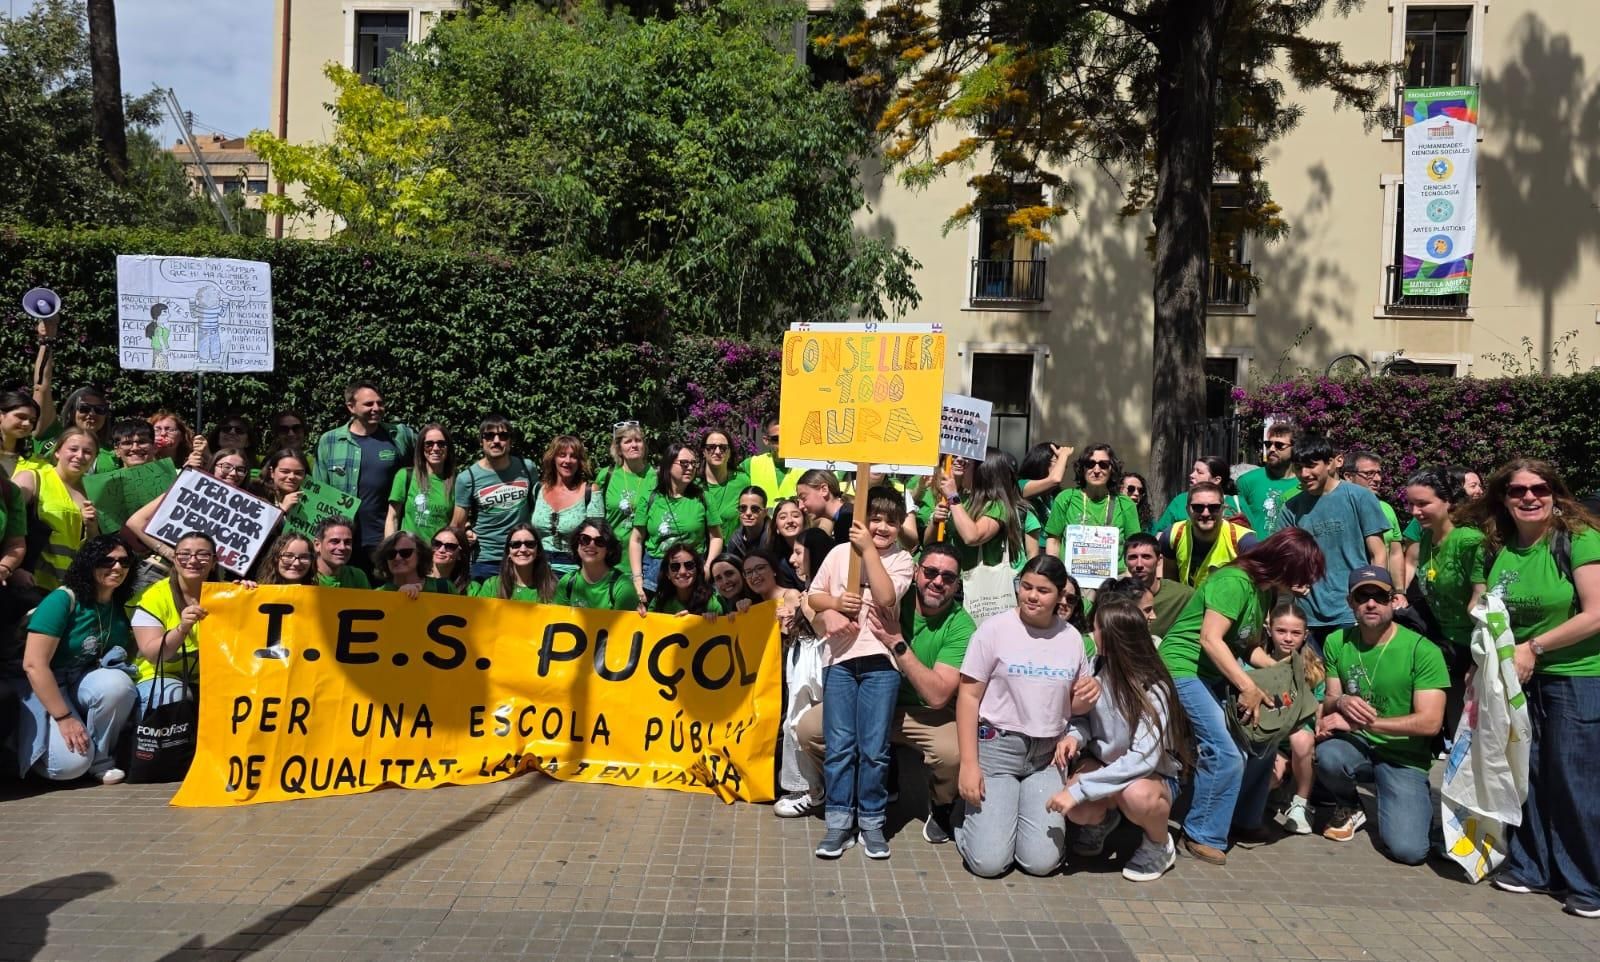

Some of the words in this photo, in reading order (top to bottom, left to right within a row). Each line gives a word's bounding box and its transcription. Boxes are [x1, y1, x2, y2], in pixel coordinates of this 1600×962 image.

[1418, 142, 1463, 150] HUMANIDADES
[124, 350, 150, 363] PAT
[229, 357, 268, 366] INFORMES
[785, 335, 945, 377] CONSELLERA
[800, 407, 924, 446] AURA
[940, 414, 975, 427] OCACIÓ,
[950, 407, 981, 419] SOBRA
[176, 487, 232, 525] TANTA
[228, 512, 263, 541] POR
[194, 476, 231, 505] PER
[228, 493, 266, 520] QUÈ
[336, 493, 355, 510] 30
[484, 489, 526, 507] SUPER
[169, 505, 251, 554] D'EDUCAR
[254, 603, 491, 671] I.E.S.
[537, 622, 757, 702] PUÇOL
[231, 695, 311, 736] PER
[351, 702, 434, 739] UNA
[469, 704, 611, 747] ESCOLA
[226, 754, 266, 793] DE
[599, 764, 641, 782] EN
